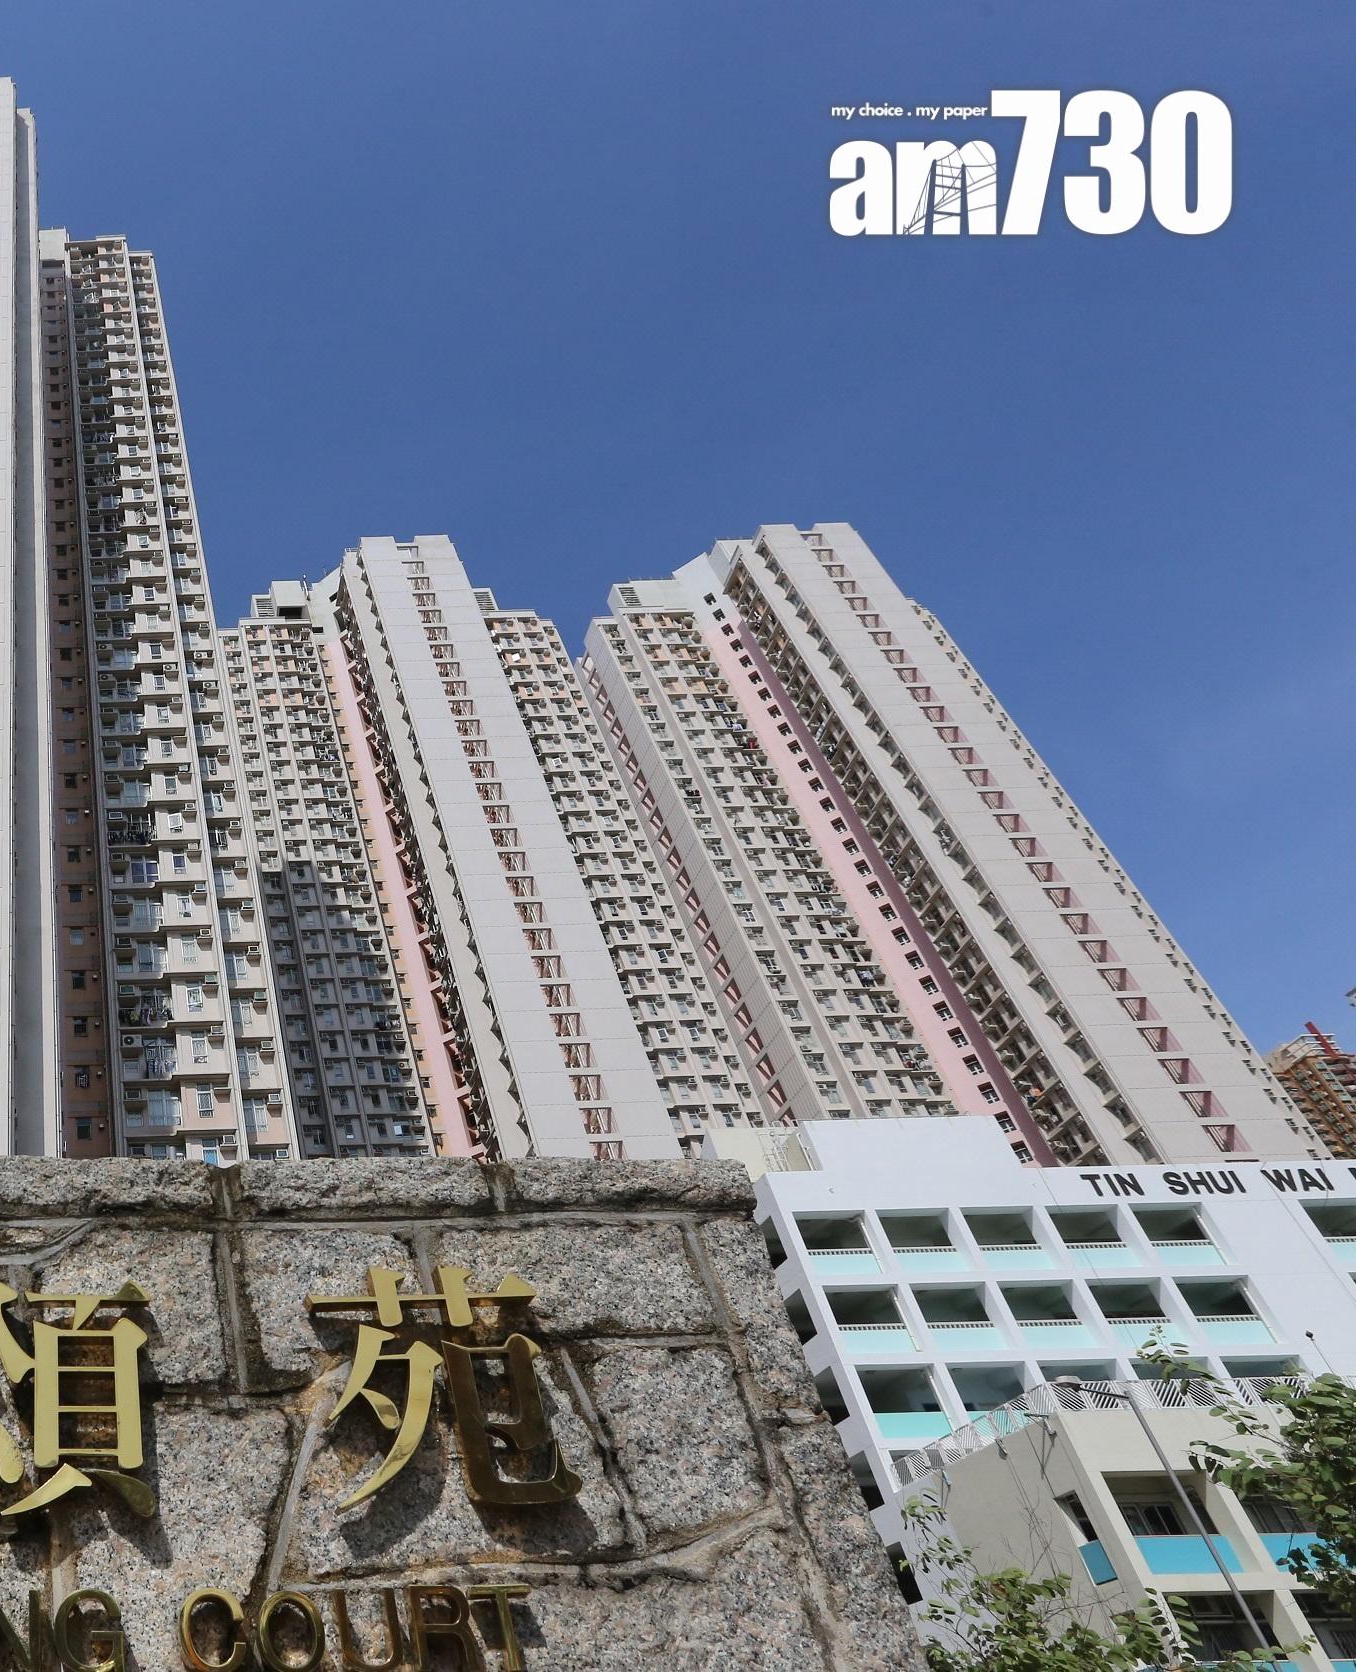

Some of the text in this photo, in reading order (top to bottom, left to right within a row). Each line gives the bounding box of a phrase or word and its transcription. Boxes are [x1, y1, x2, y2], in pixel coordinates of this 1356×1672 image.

[1080, 1173, 1144, 1197] TIN
[1162, 1170, 1247, 1196] SHUI
[1260, 1168, 1335, 1192] WAI
[179, 1584, 532, 1672] COURT
